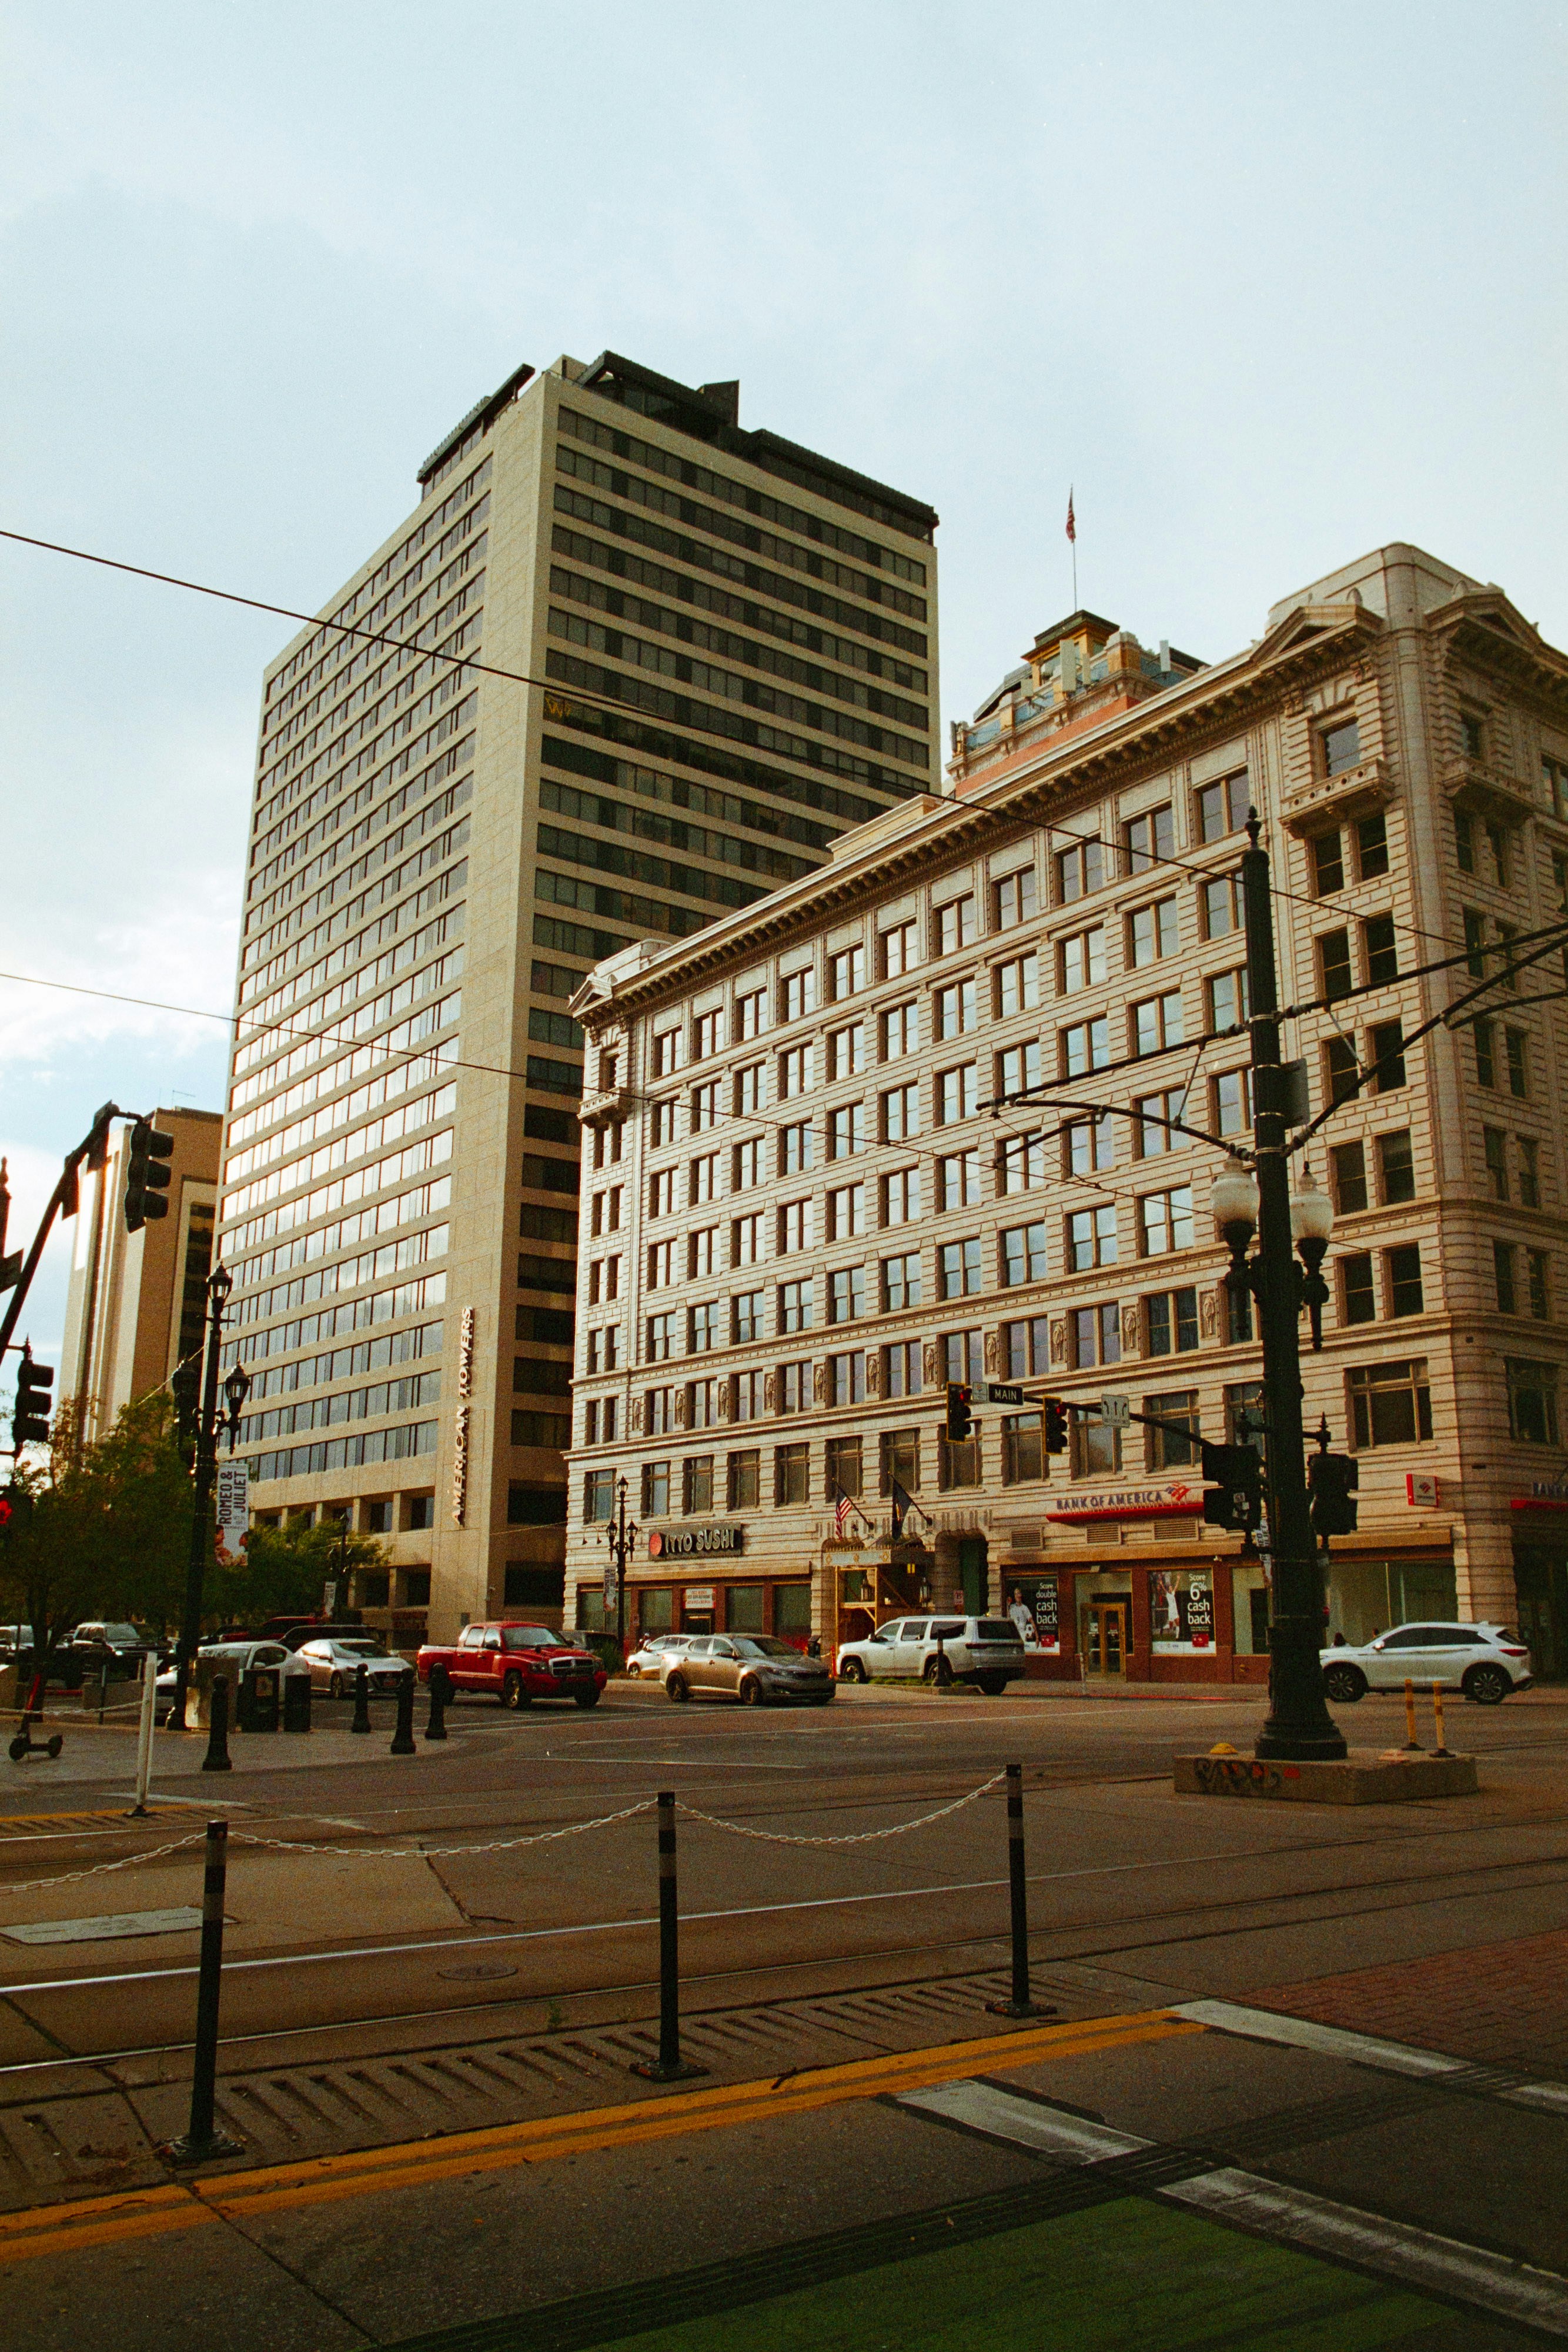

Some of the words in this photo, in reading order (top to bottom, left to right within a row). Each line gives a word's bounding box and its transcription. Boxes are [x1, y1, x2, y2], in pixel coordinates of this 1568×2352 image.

[459, 1306, 473, 1398] TOWERS
[994, 1388, 1017, 1401] MAIN
[452, 1406, 469, 1525] AMERICAN
[220, 1471, 233, 1480] &
[233, 1471, 246, 1513] JULIET
[219, 1484, 232, 1524] ROMEO
[1057, 1498, 1088, 1510] BANK
[1091, 1495, 1105, 1507] OF
[1108, 1491, 1164, 1506] AMERICA
[665, 1532, 693, 1553] ITTO
[696, 1529, 734, 1551] SUSHI
[1036, 1589, 1057, 1598] double
[1190, 1581, 1208, 1601] 6%
[1036, 1598, 1057, 1611] cash
[1187, 1599, 1210, 1611] cash
[1036, 1612, 1058, 1624] back
[1188, 1612, 1211, 1625] back
